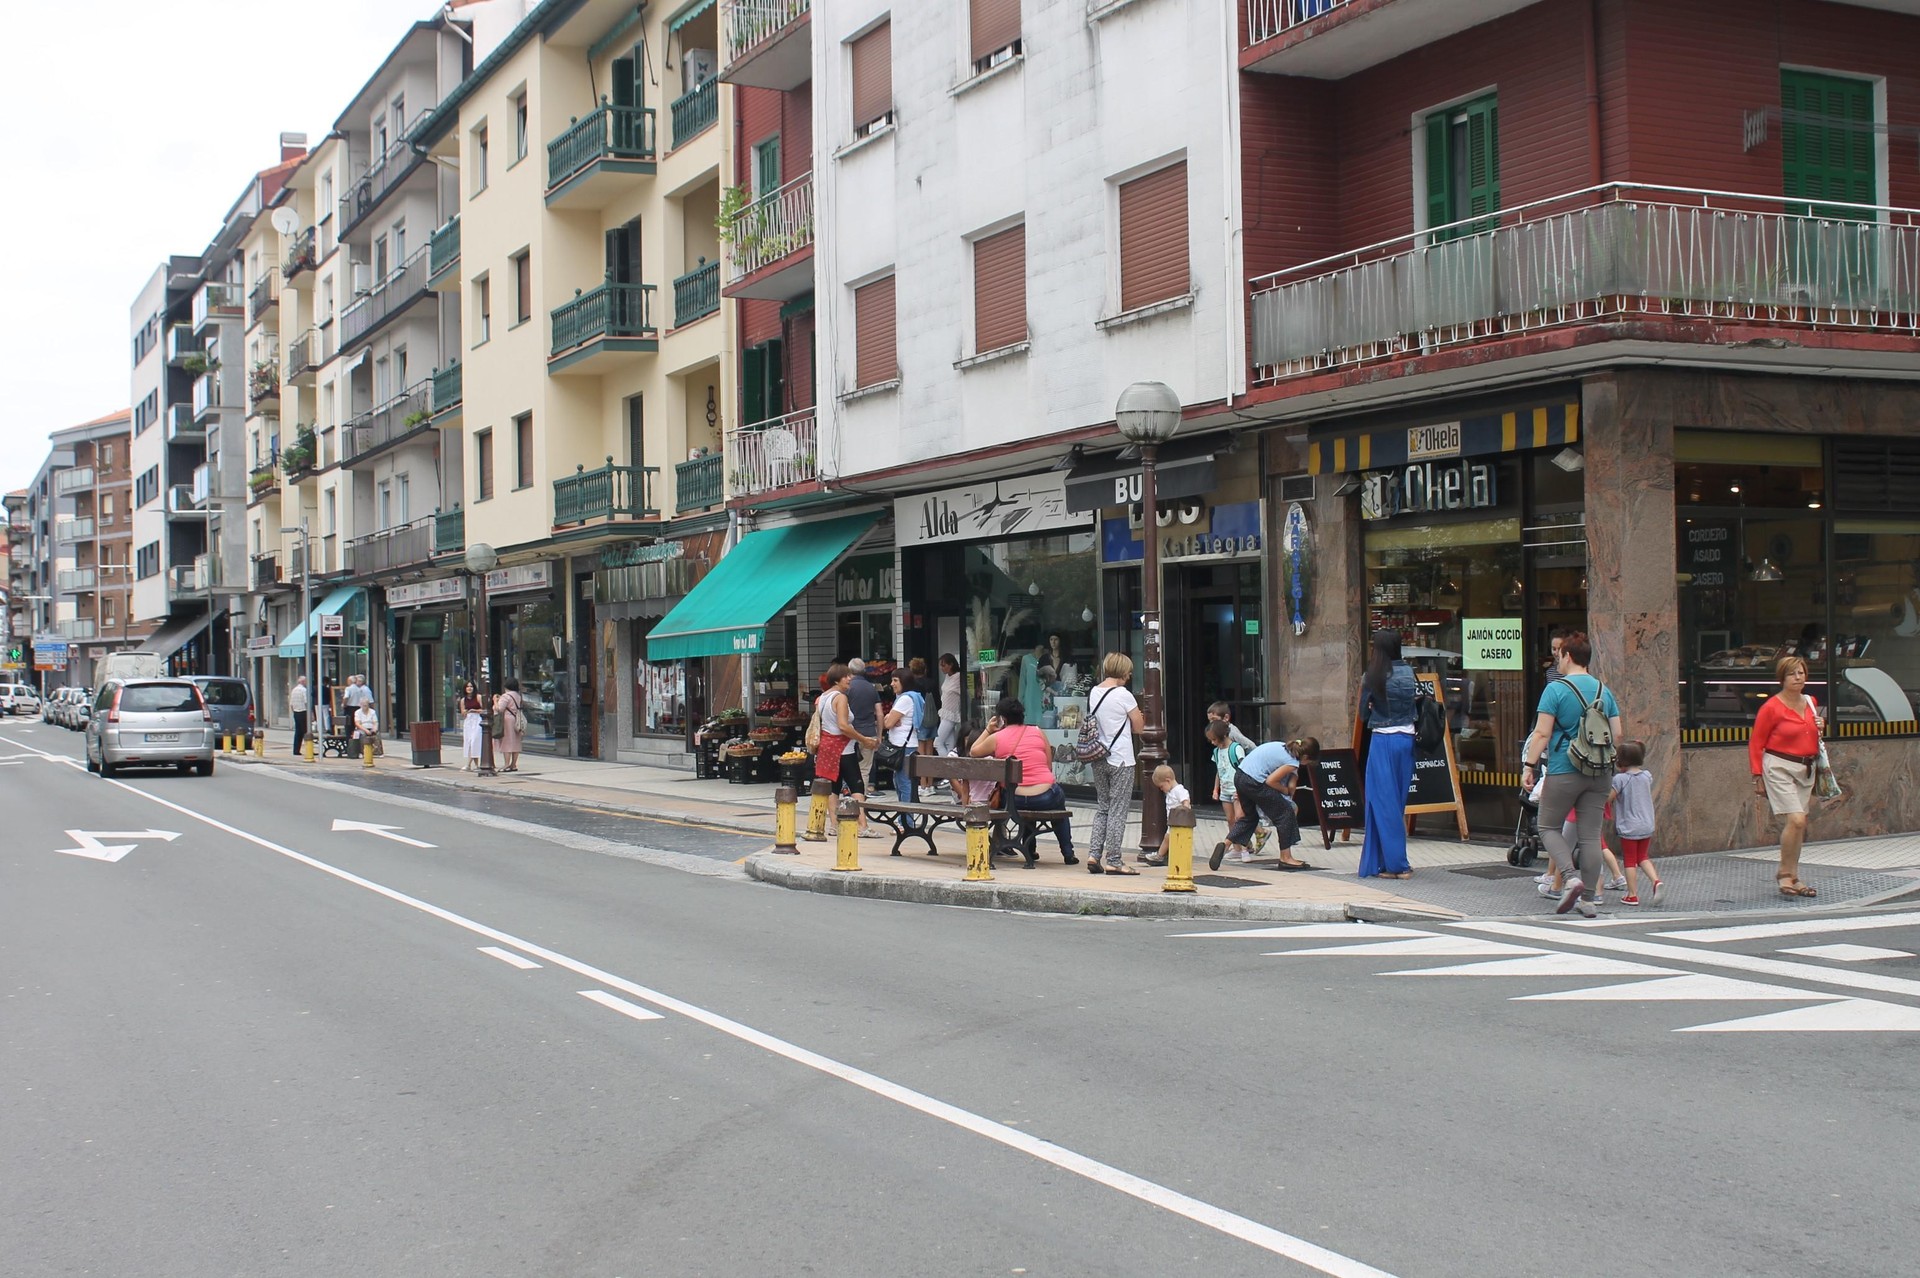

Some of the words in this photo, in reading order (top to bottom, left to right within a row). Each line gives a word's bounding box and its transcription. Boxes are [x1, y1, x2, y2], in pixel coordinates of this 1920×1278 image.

[1425, 425, 1459, 451] Okela
[1115, 474, 1158, 504] BU
[1405, 459, 1491, 511] Okela
[919, 496, 959, 540] Alda
[1688, 528, 1727, 542] CORDERO
[1693, 549, 1720, 562] ASADO
[1467, 626, 1494, 641] JAMÓN
[1495, 628, 1523, 641] COCID
[1481, 647, 1513, 660] CASERO
[1320, 761, 1341, 769] TOMATE
[1415, 758, 1445, 769] ESPINACAS
[1328, 773, 1338, 782] DE
